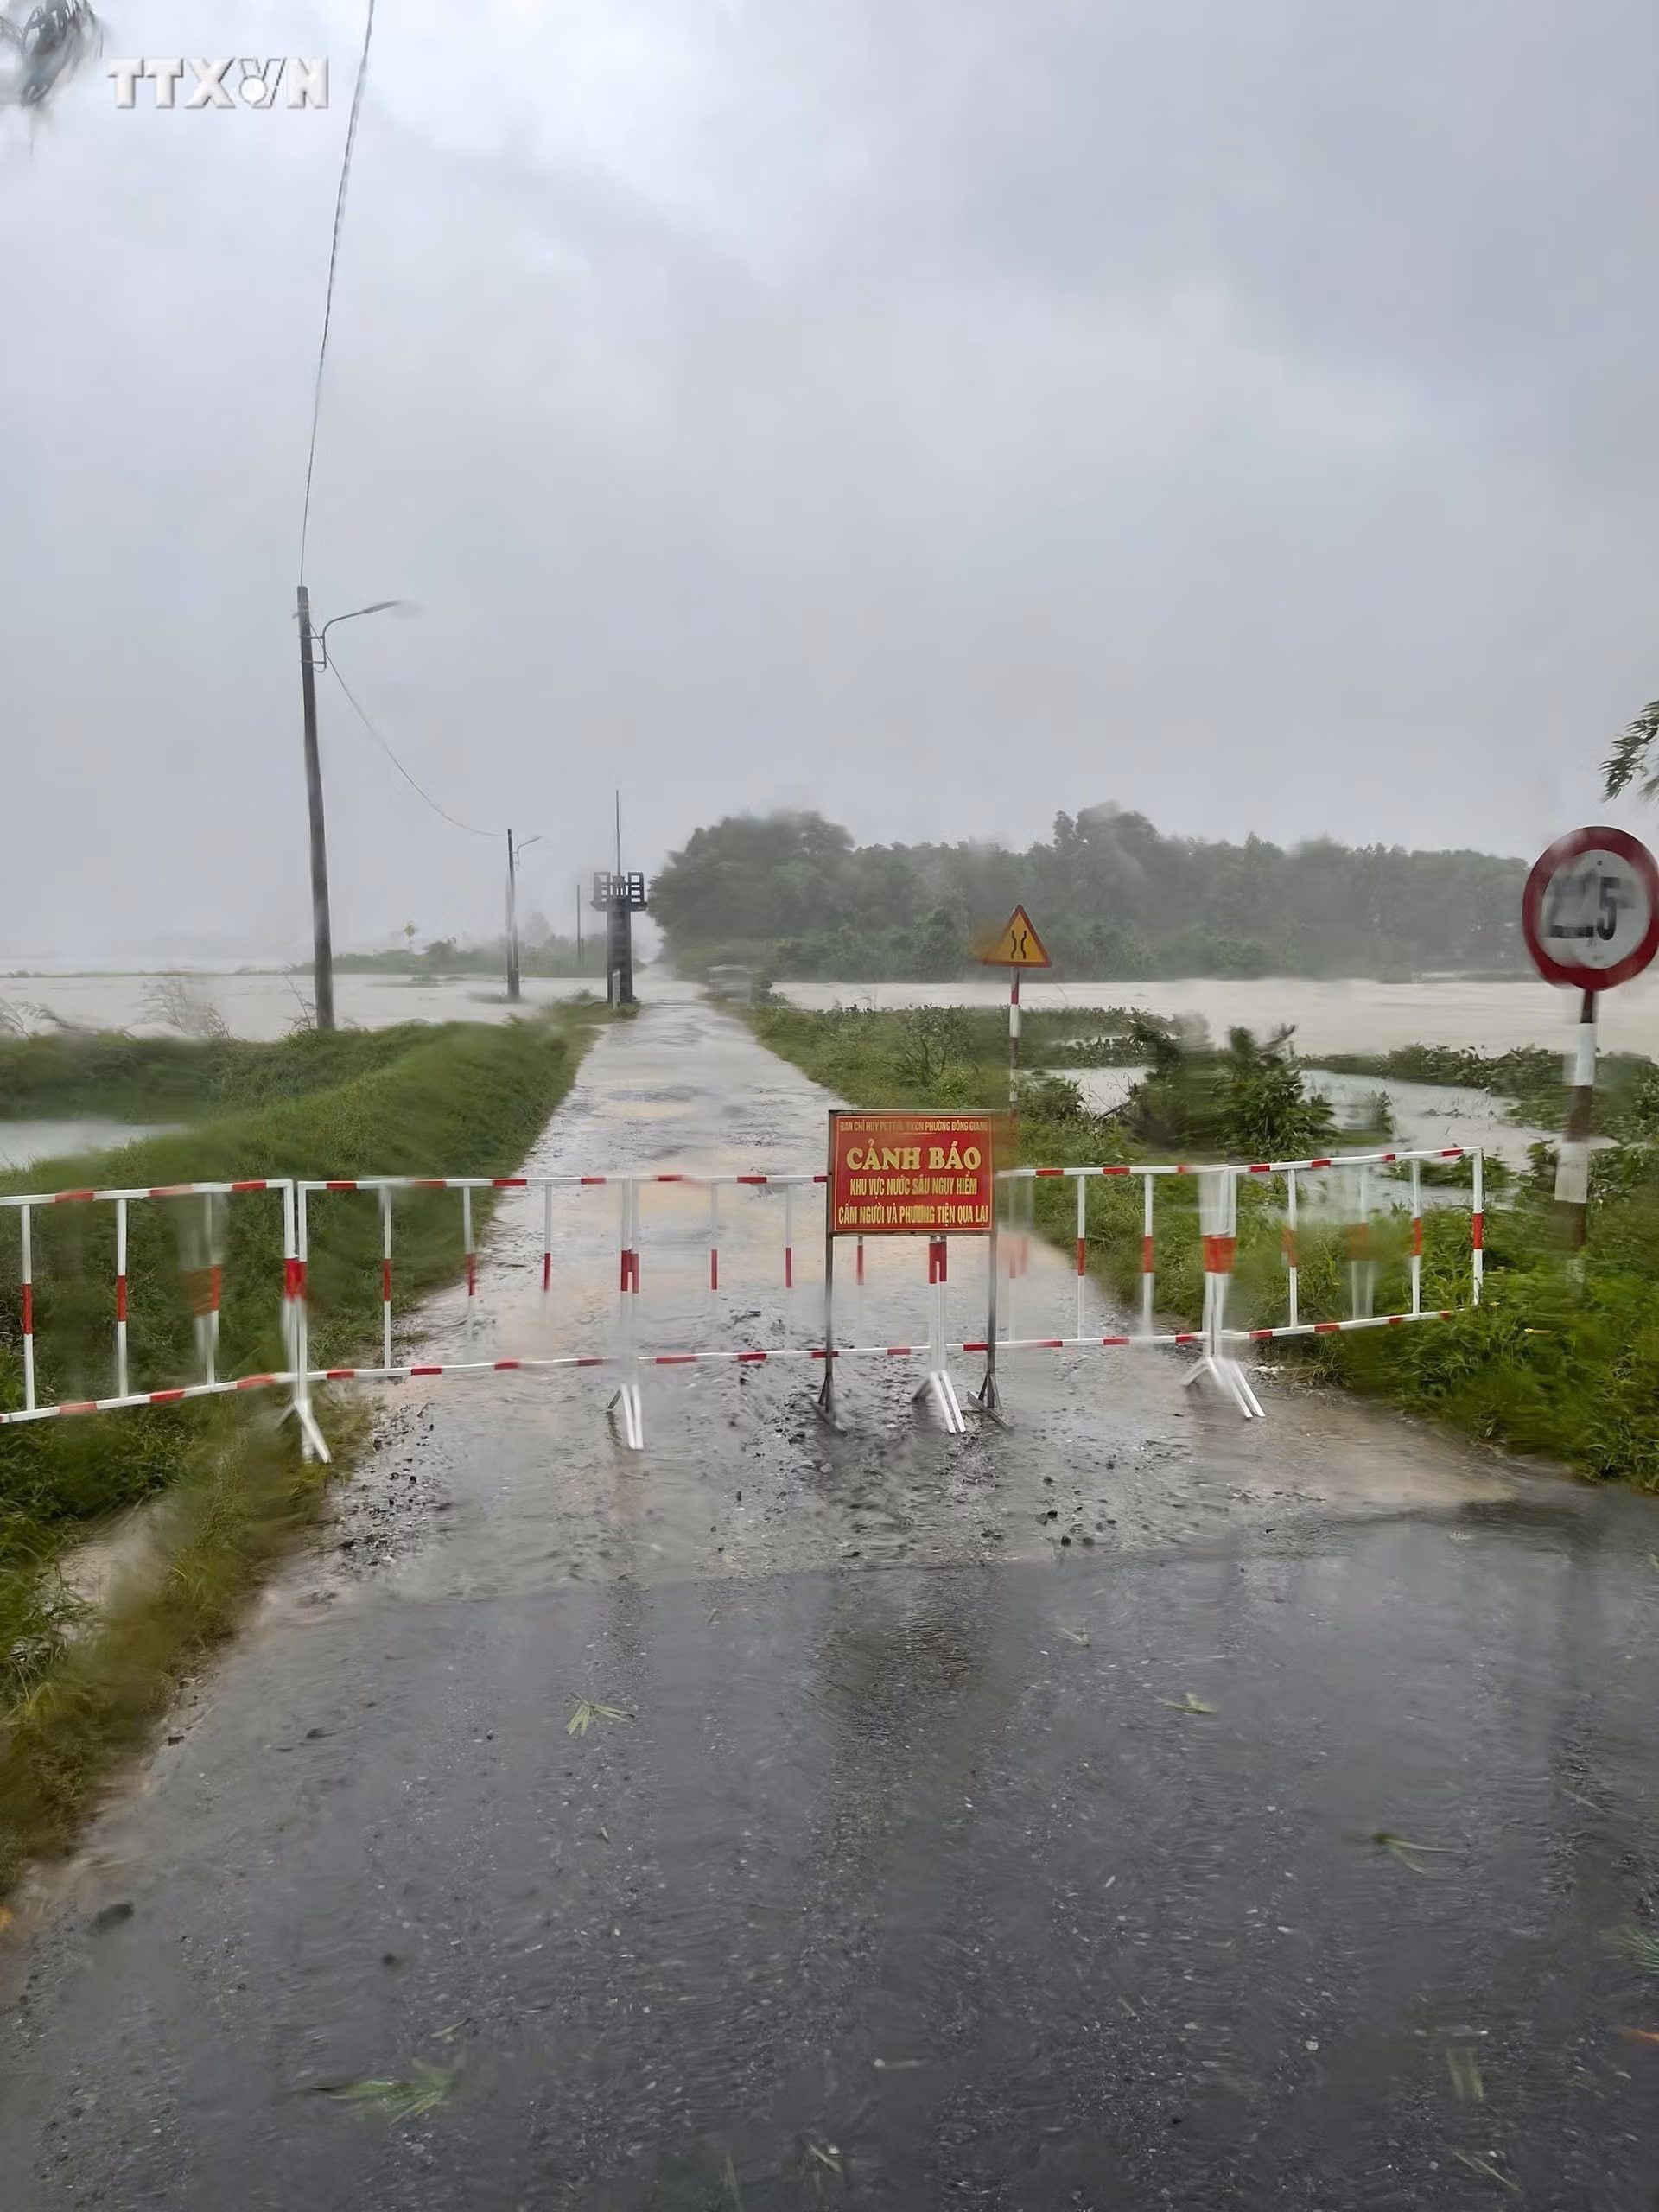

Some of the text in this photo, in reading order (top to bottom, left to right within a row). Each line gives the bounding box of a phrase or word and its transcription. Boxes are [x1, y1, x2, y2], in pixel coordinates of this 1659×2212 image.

[840, 1121, 853, 1132] BAN
[866, 1121, 880, 1132] HUY
[925, 1119, 950, 1132] PHƯỜNG
[846, 1138, 982, 1171] CẢNH BÁO
[849, 1171, 977, 1199] KHU VỰC NƯỚC SÂU NGUY HIỂM
[838, 1200, 858, 1224] CẤM
[860, 1202, 885, 1224] NGƯỜI
[887, 1202, 898, 1224] VÀ
[937, 1202, 956, 1227] TIỆN
[957, 1205, 973, 1225] QUA
[975, 1205, 988, 1226] LẠI
